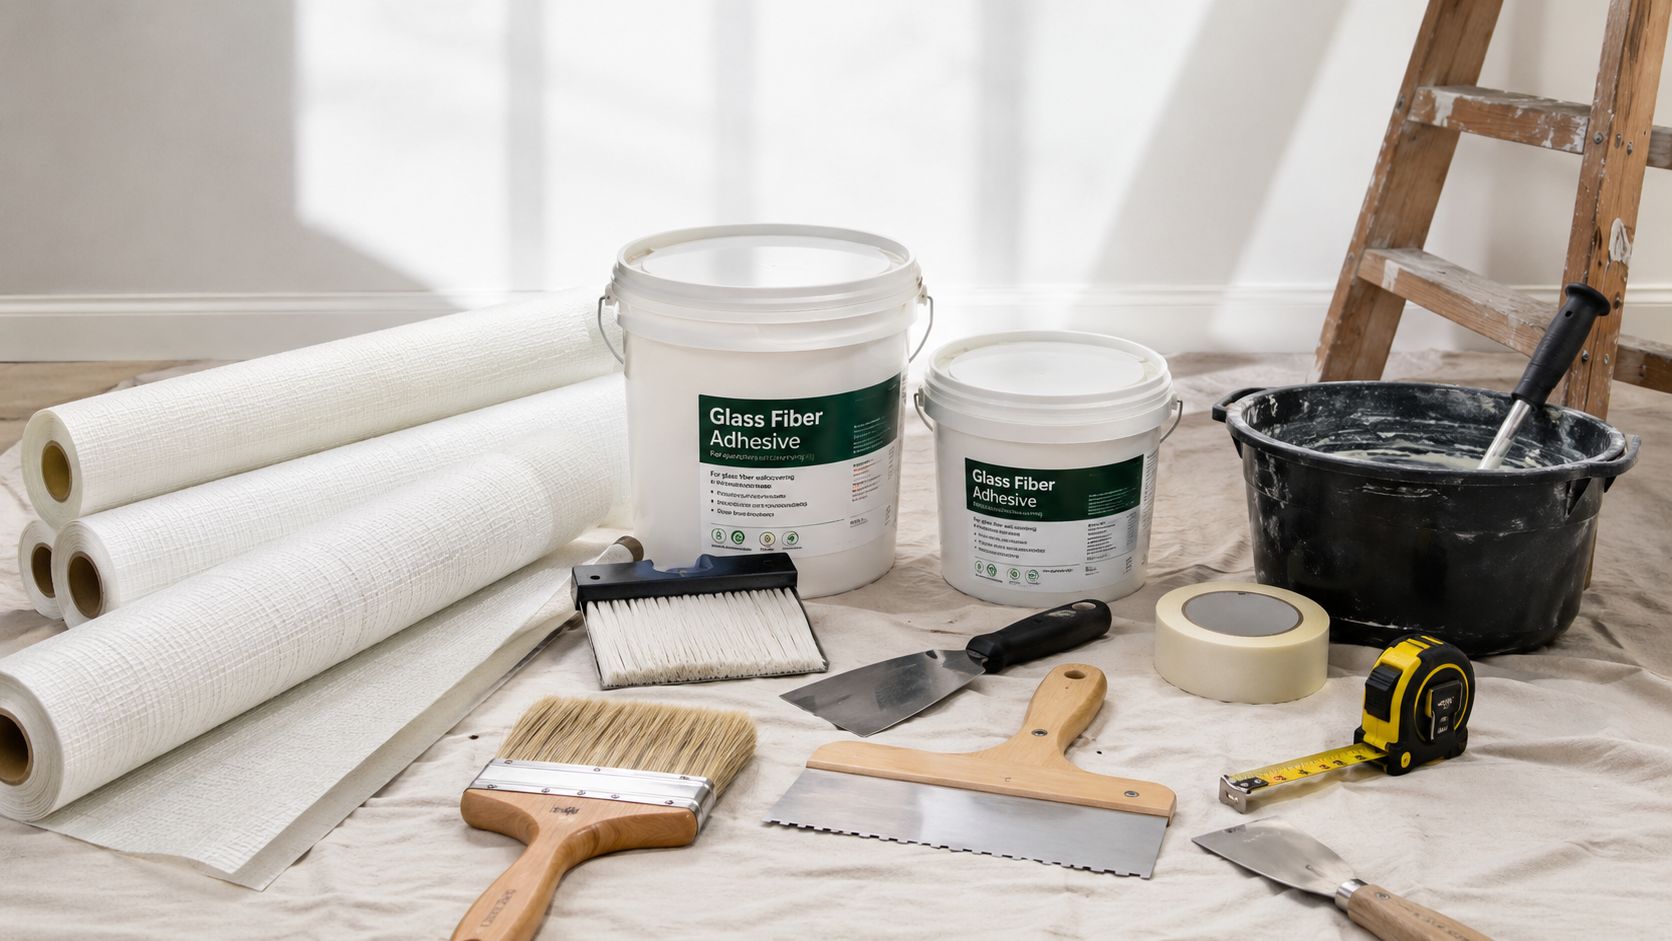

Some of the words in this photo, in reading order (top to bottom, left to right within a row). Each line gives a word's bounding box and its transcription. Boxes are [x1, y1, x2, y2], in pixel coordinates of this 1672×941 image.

[709, 407, 765, 428] Glass
[771, 409, 824, 428] Fiber
[710, 429, 801, 450] Adhesive
[972, 468, 1011, 489] Glass
[1014, 475, 1056, 492] Fiber
[972, 486, 1038, 508] Adhesive
